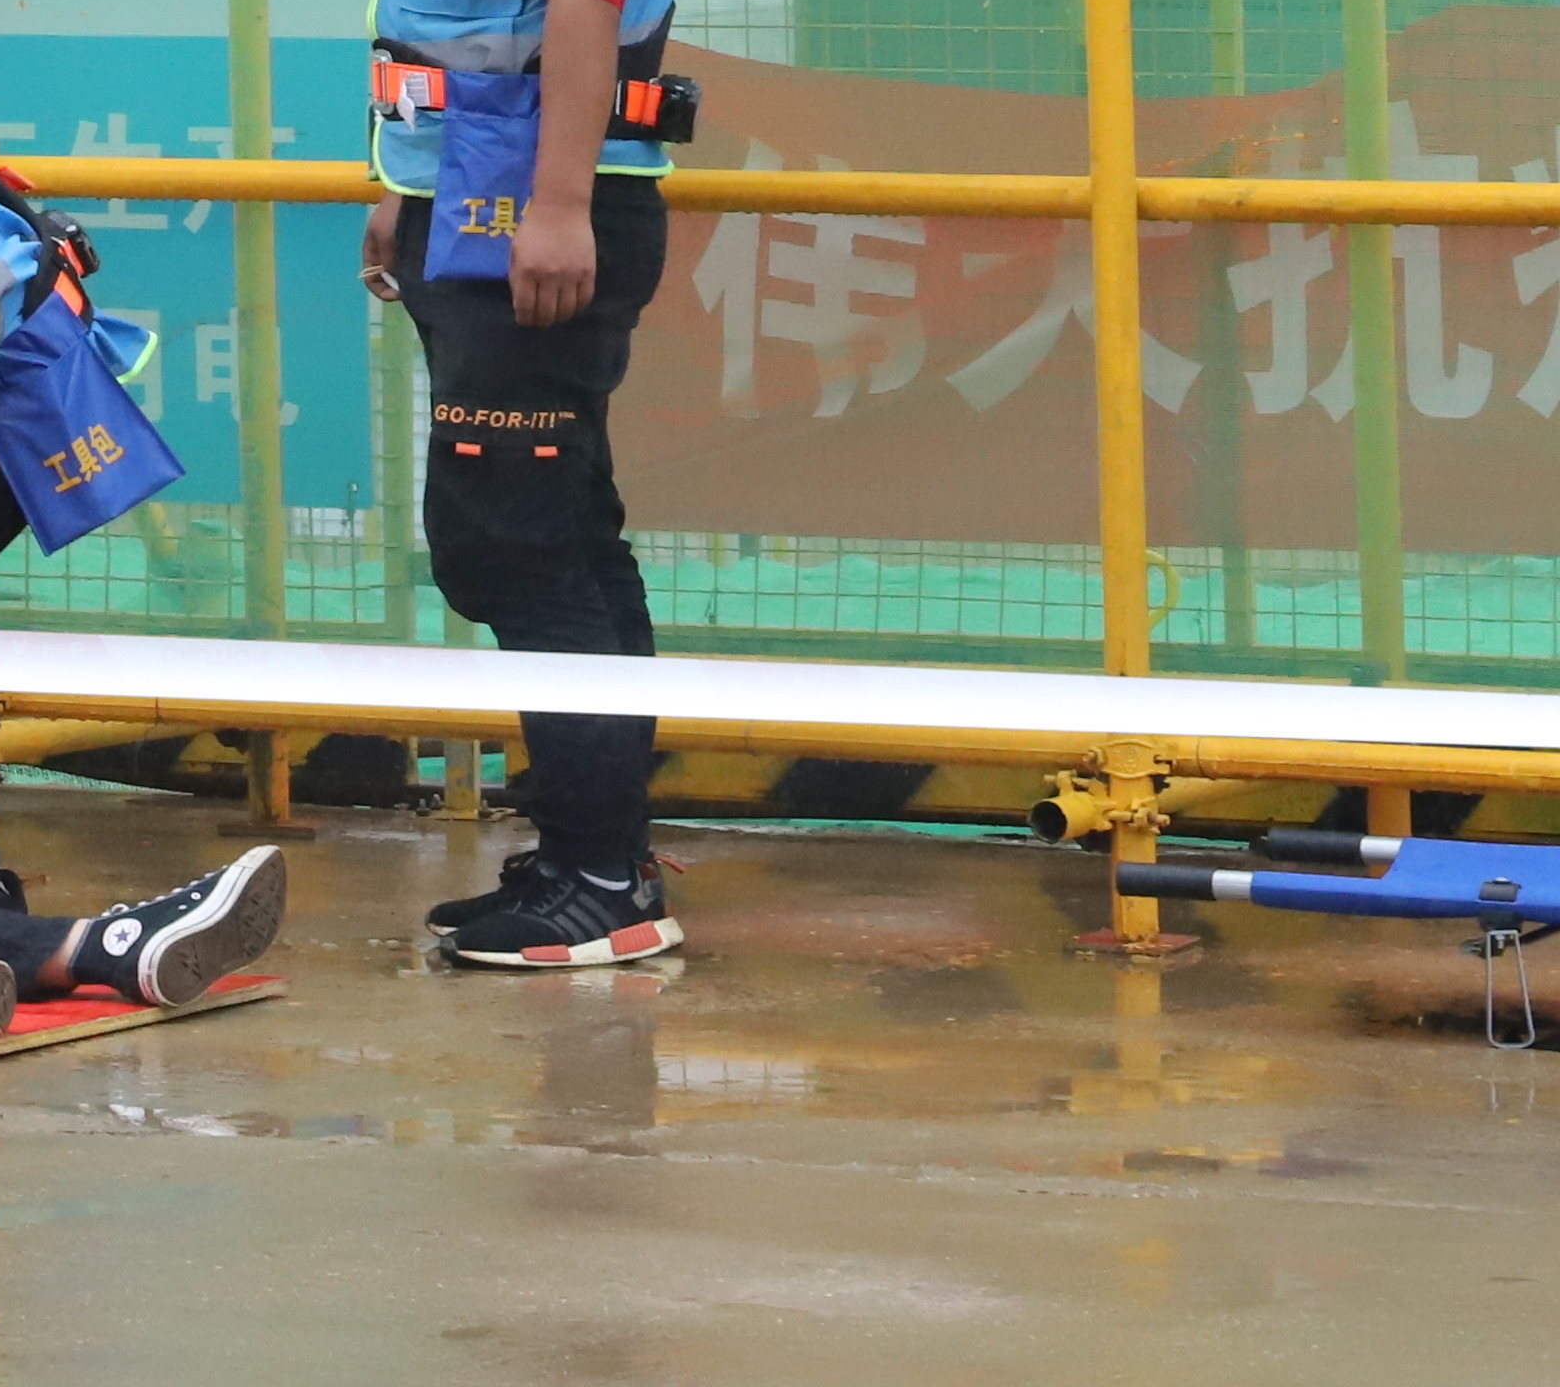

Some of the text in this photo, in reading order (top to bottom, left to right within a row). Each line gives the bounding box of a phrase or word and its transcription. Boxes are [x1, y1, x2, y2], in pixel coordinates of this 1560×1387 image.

[458, 195, 531, 239] 工具
[434, 403, 556, 429] GO-FOR-IT!
[42, 423, 126, 495] 工具包
